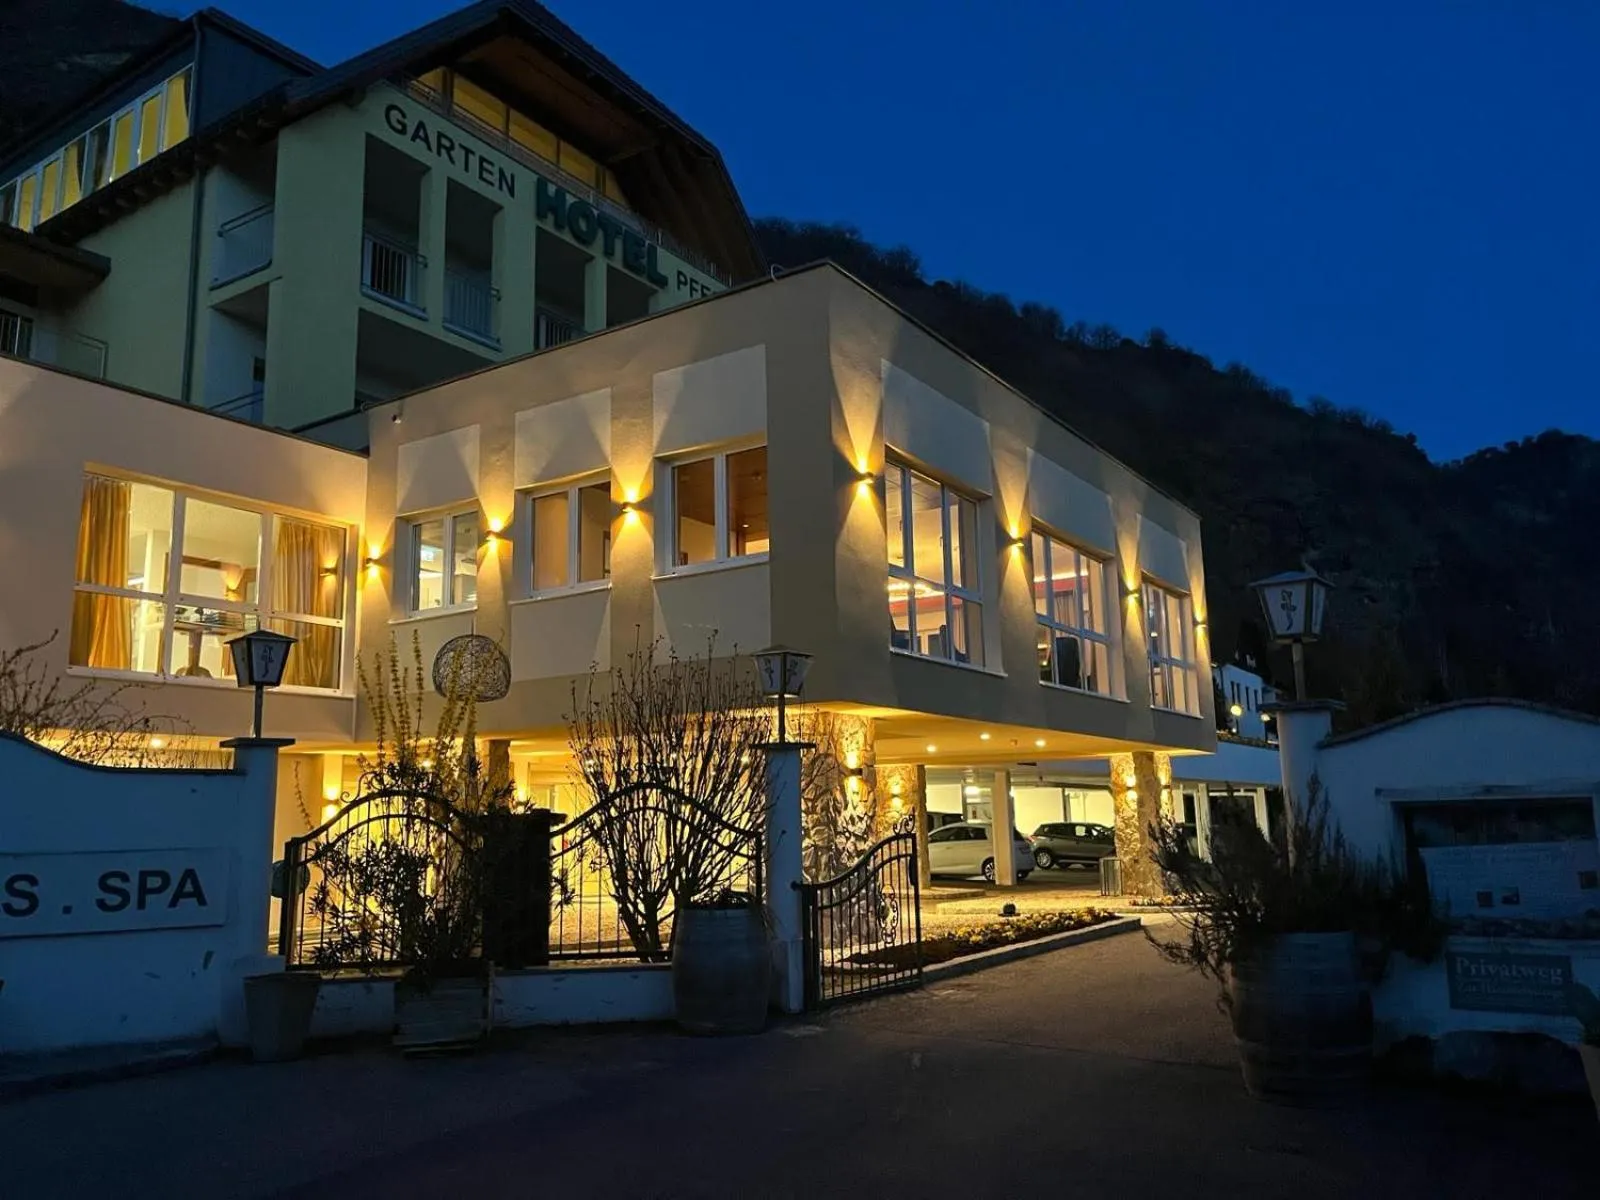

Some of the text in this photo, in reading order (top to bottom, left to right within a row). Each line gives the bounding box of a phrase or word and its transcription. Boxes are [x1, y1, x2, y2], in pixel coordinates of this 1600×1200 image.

[384, 104, 515, 198] GARTEN
[536, 176, 668, 288] HOTEL
[96, 868, 208, 912] SPA
[1455, 957, 1563, 985] Privatweg
